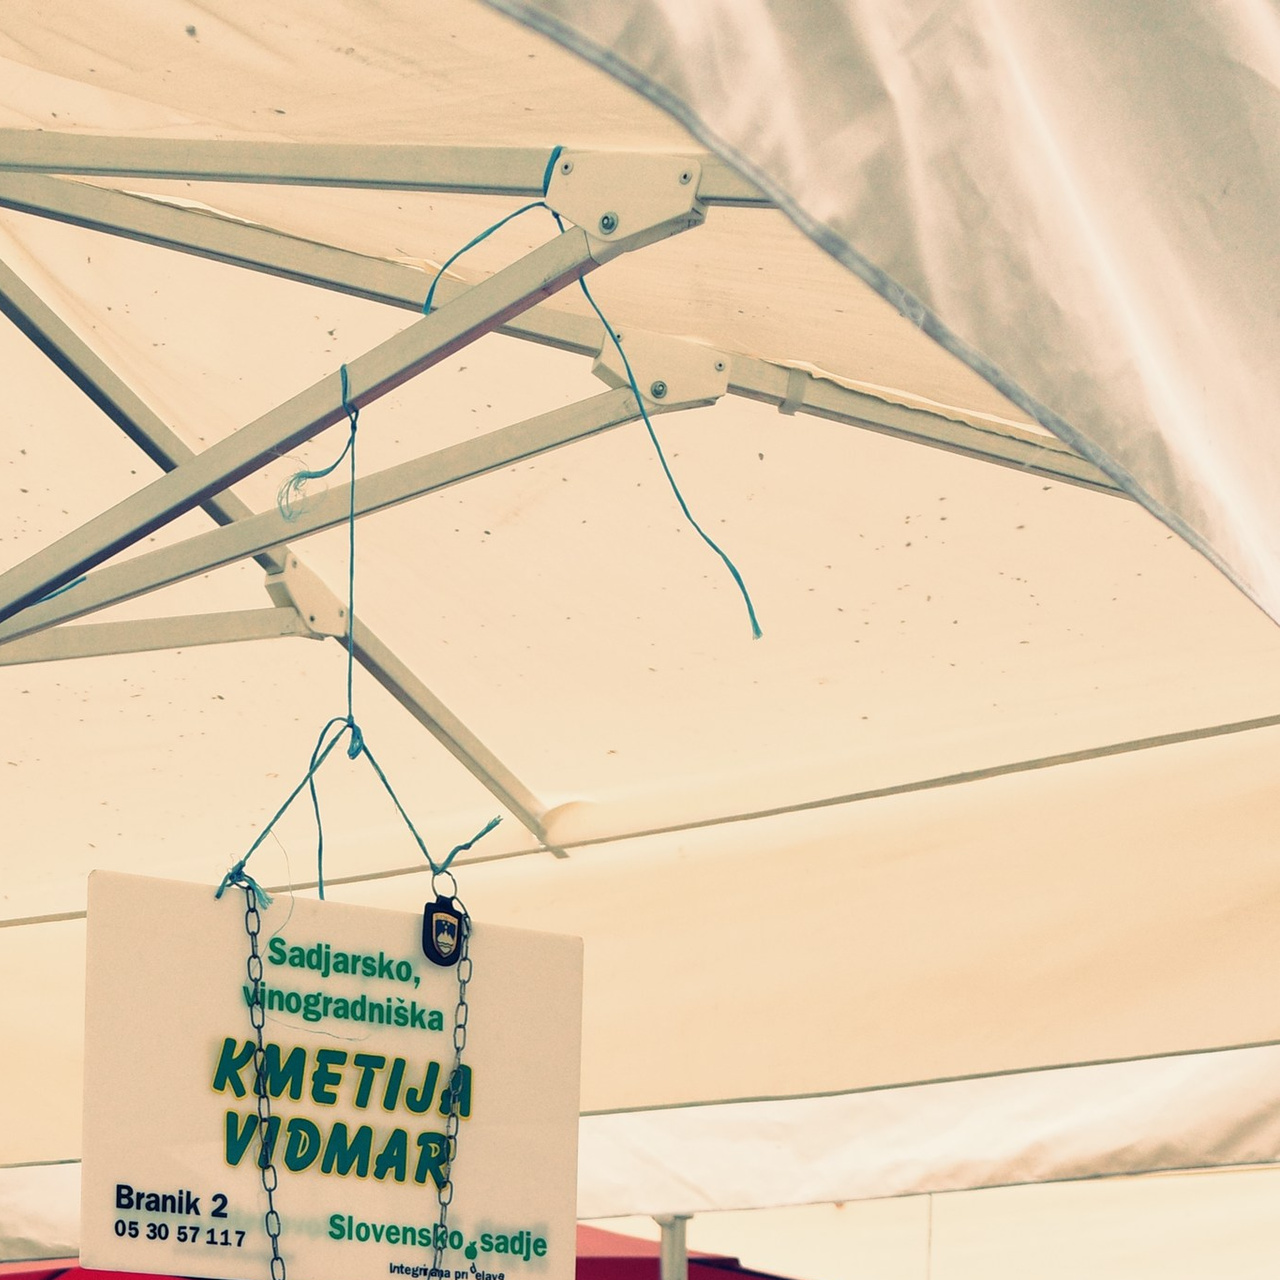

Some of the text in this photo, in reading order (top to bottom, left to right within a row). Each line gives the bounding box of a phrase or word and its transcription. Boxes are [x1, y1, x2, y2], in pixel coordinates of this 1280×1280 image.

[267, 937, 421, 988] Sadjarsko,
[242, 983, 444, 1032] vinogradniška
[211, 1036, 474, 1120] KMETIJA
[223, 1109, 452, 1189] VIDMAR
[116, 1184, 228, 1218] Branik 2
[114, 1219, 246, 1247] 05 30 57 117
[328, 1213, 548, 1262] Slovensko sadje
